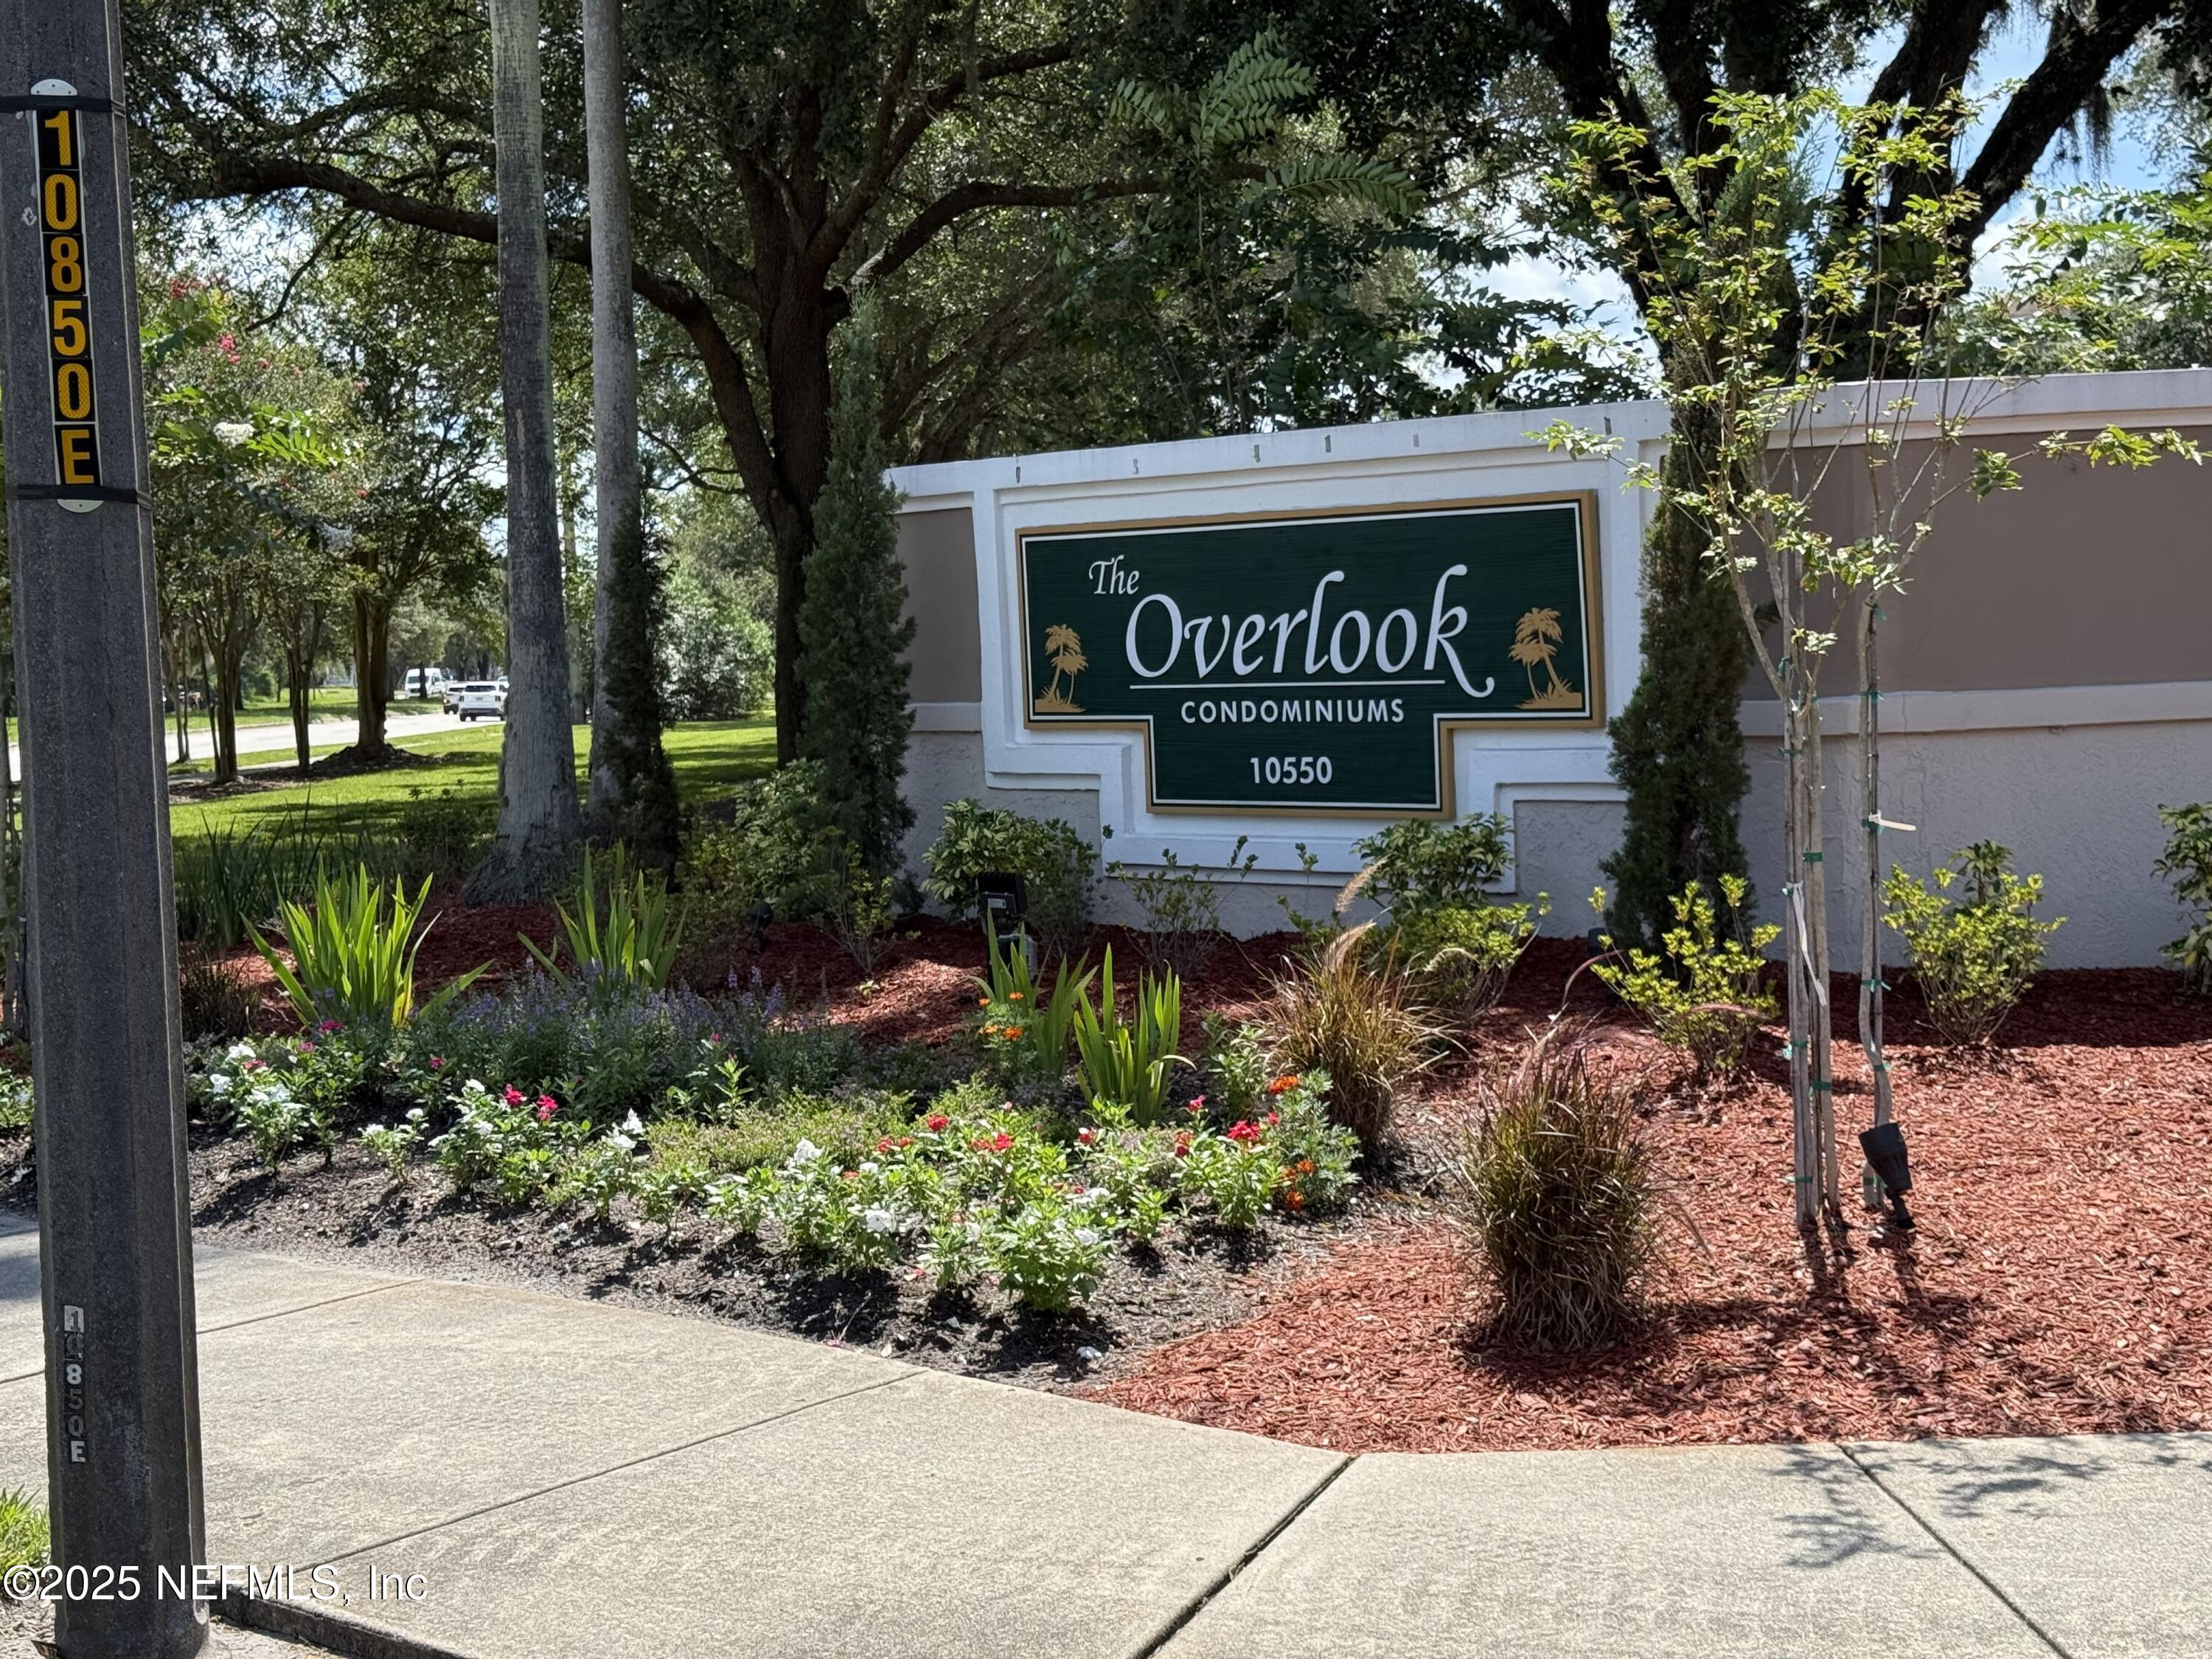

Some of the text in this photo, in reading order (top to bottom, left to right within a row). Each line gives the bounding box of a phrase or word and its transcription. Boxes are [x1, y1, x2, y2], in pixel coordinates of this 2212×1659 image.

[44, 111, 94, 484] 10850E
[1088, 554, 1140, 595] The
[1125, 564, 1495, 698] Overlook
[1180, 698, 1405, 724] CONDOMINIUMS
[1250, 756, 1333, 785] 10550
